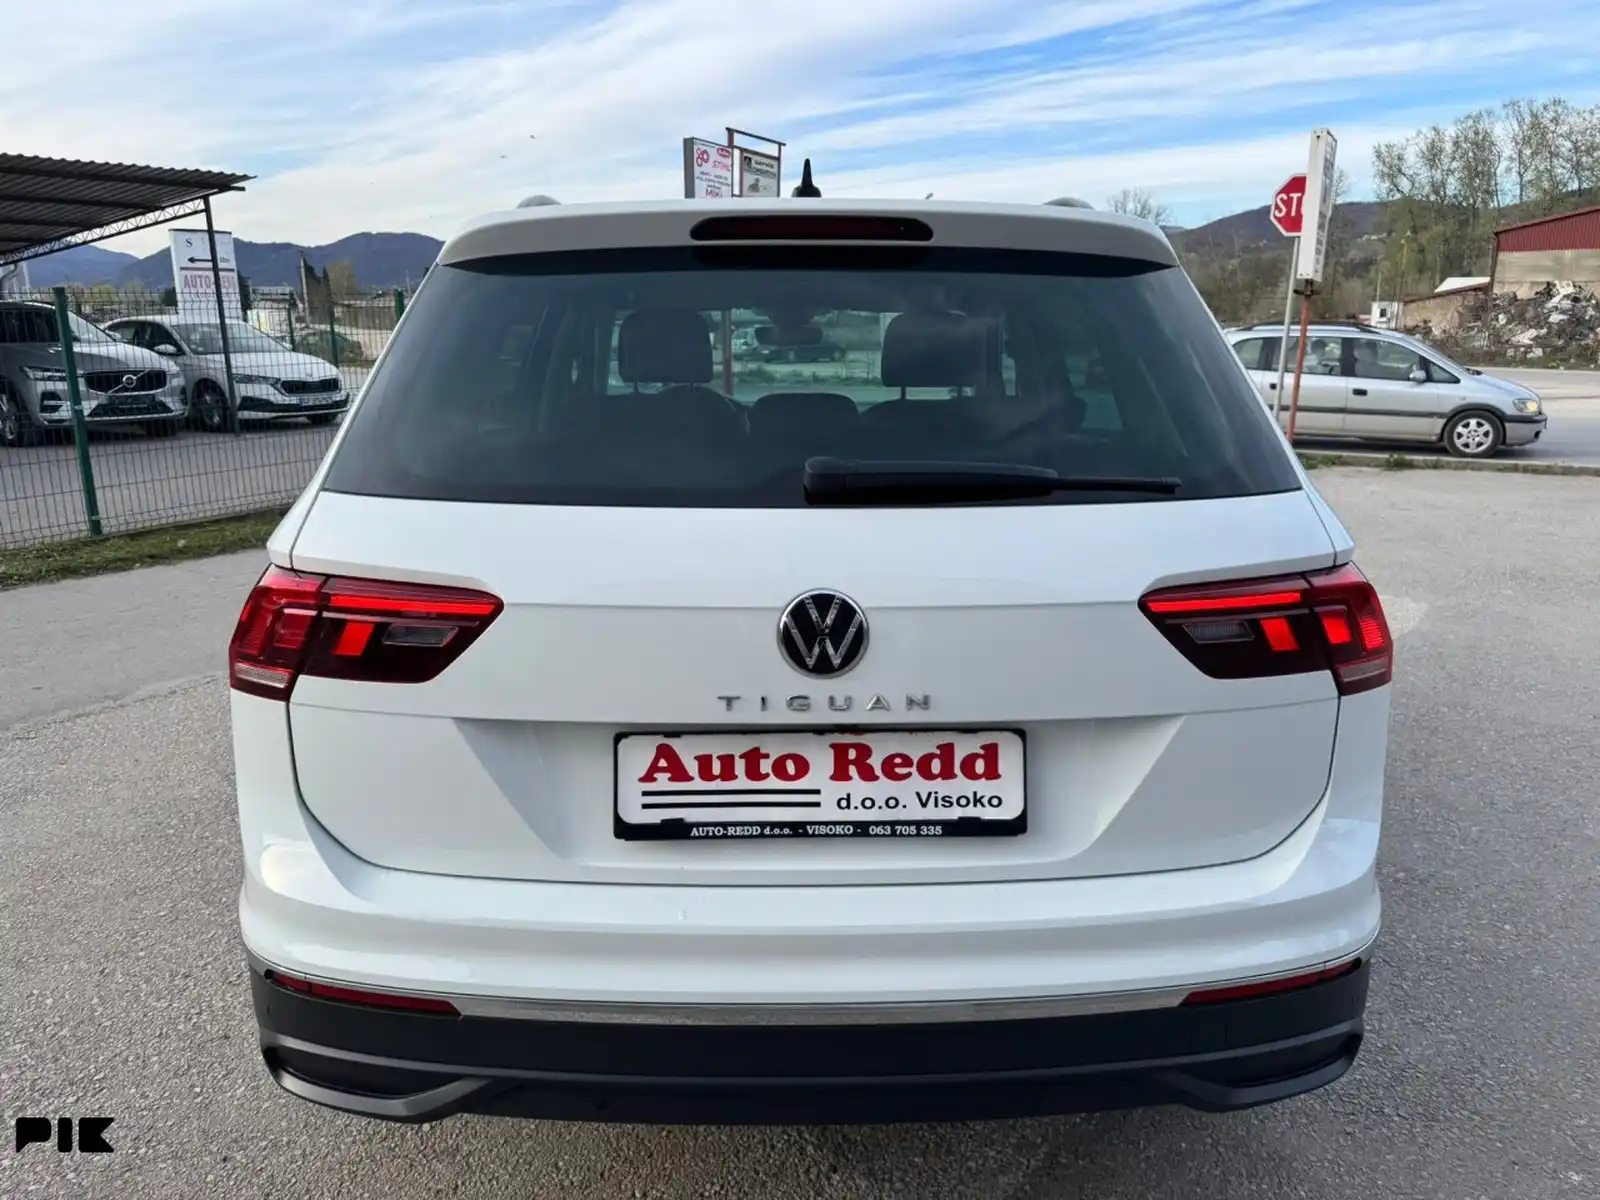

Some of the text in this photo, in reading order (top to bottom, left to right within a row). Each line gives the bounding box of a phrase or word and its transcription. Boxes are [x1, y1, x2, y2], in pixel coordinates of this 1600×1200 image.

[1274, 192, 1304, 217] ST
[717, 695, 931, 711] TIGUAN
[638, 742, 1002, 783] Auto Redd
[836, 791, 1003, 810] d.o.o. Visoko
[690, 827, 761, 837] AUTO-REDD
[764, 826, 793, 835] d.o.o.
[807, 825, 854, 835] VISOKO
[869, 825, 891, 835] 063
[895, 825, 917, 835] 705
[920, 825, 943, 835] 335
